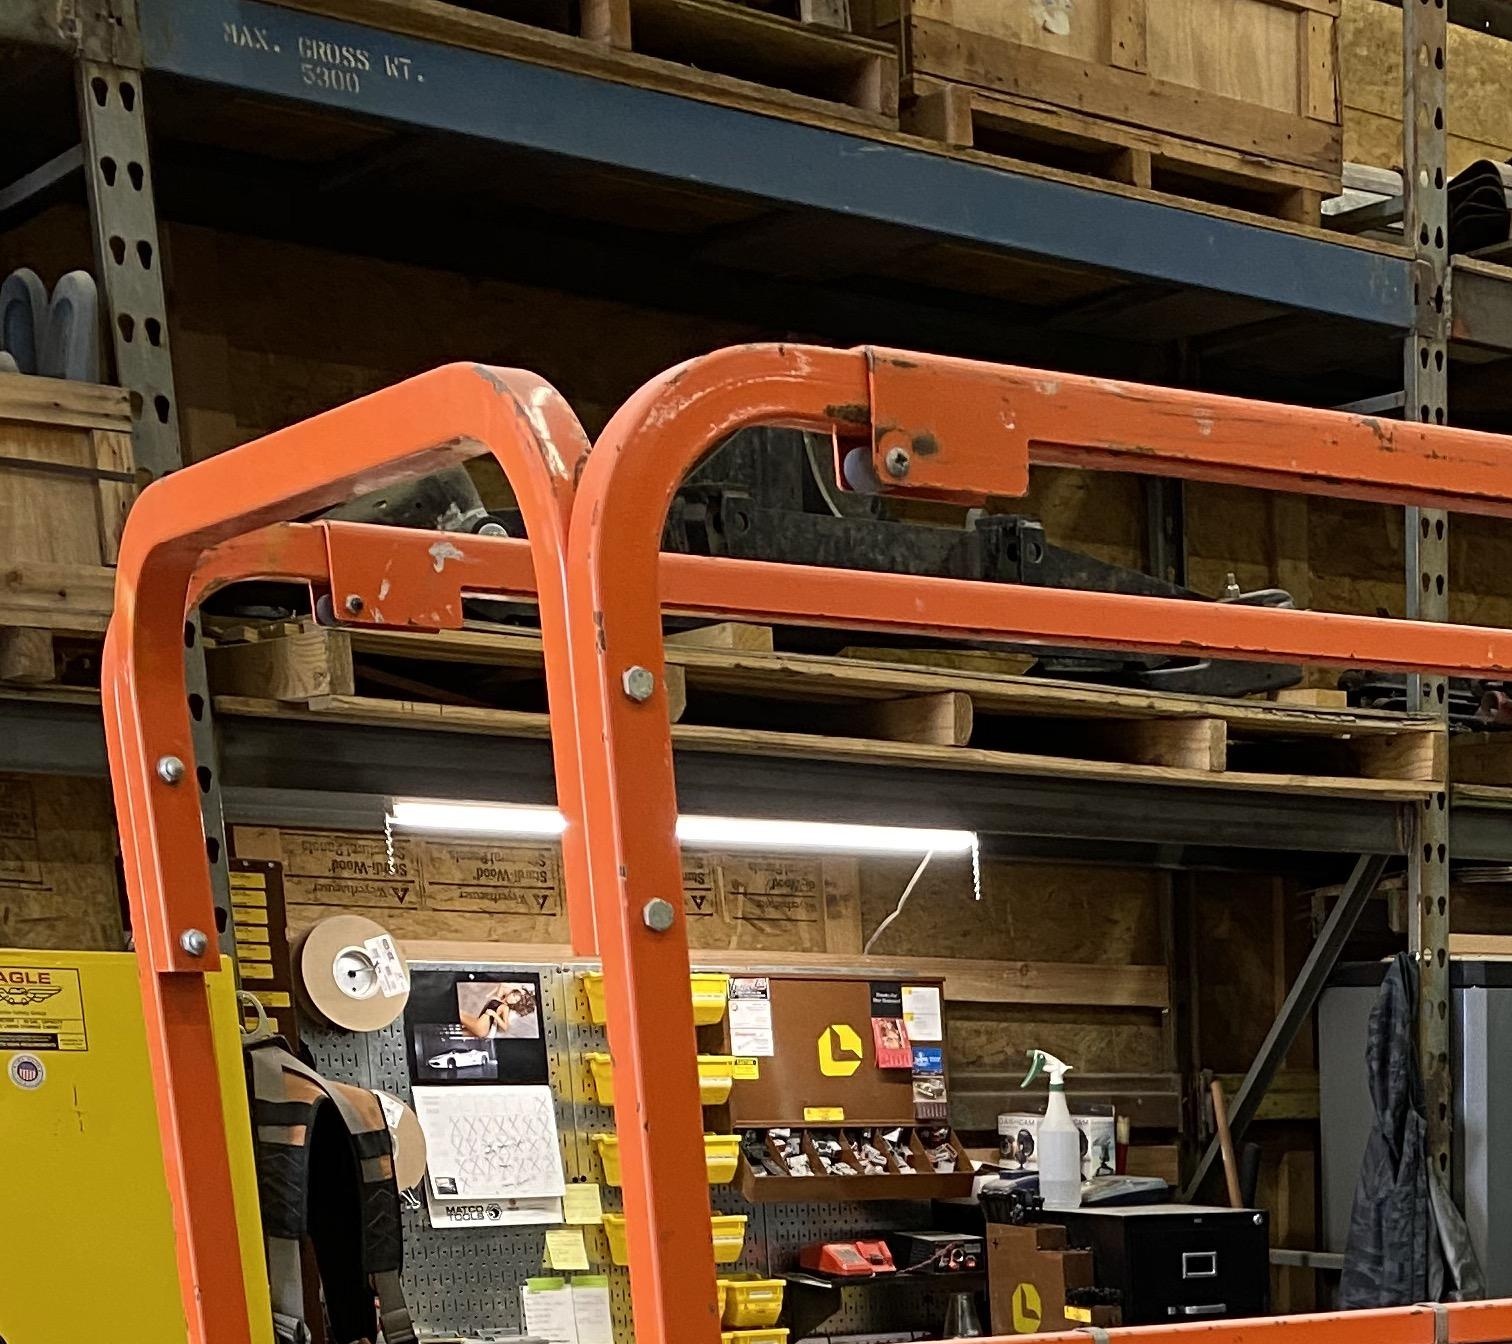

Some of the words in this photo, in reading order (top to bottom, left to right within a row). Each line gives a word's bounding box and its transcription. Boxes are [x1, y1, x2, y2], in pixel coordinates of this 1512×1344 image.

[223, 21, 280, 52] MAX.
[299, 37, 370, 71] GROSS
[0, 972, 51, 985] AGLE
[446, 1205, 484, 1215] MATCO
[448, 1211, 485, 1222] TOOLS
